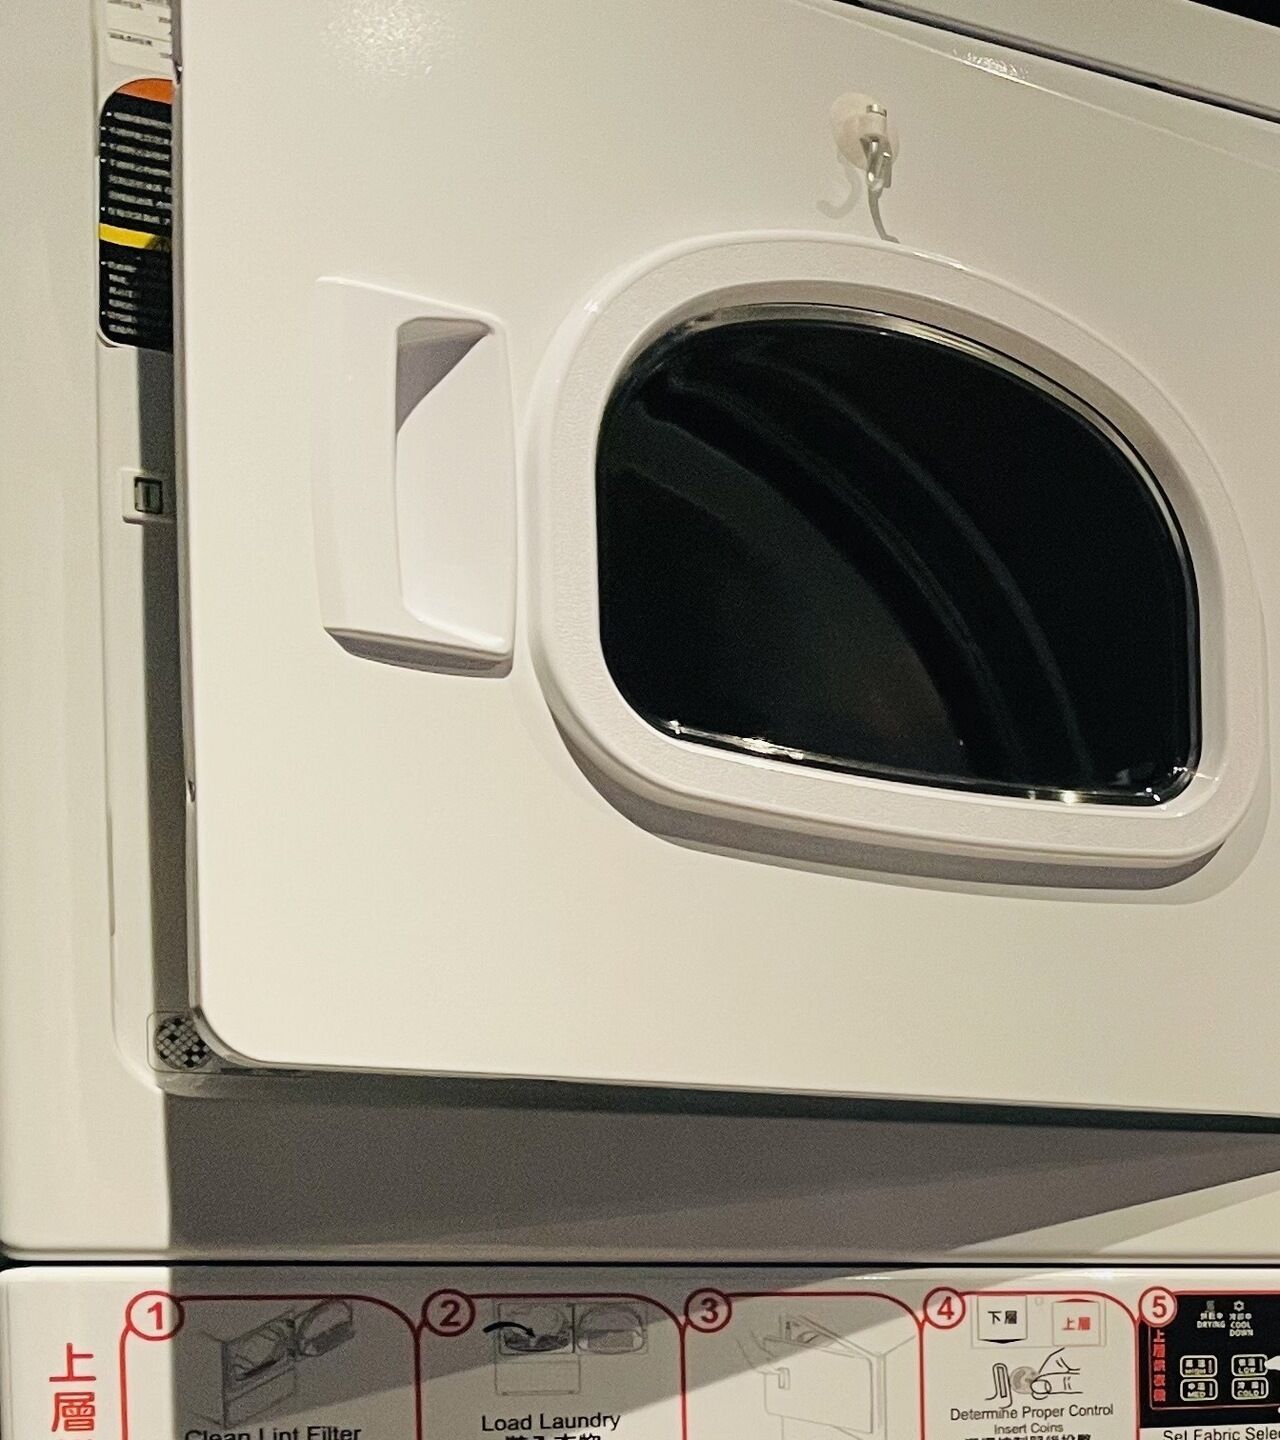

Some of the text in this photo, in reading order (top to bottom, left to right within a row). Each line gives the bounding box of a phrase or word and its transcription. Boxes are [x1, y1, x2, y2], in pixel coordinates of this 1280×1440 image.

[988, 1311, 1018, 1325] 下層
[951, 1404, 1113, 1421] Determine Proper Control
[482, 1411, 621, 1432] Load Laundry
[994, 1422, 1063, 1434] Insert Coins
